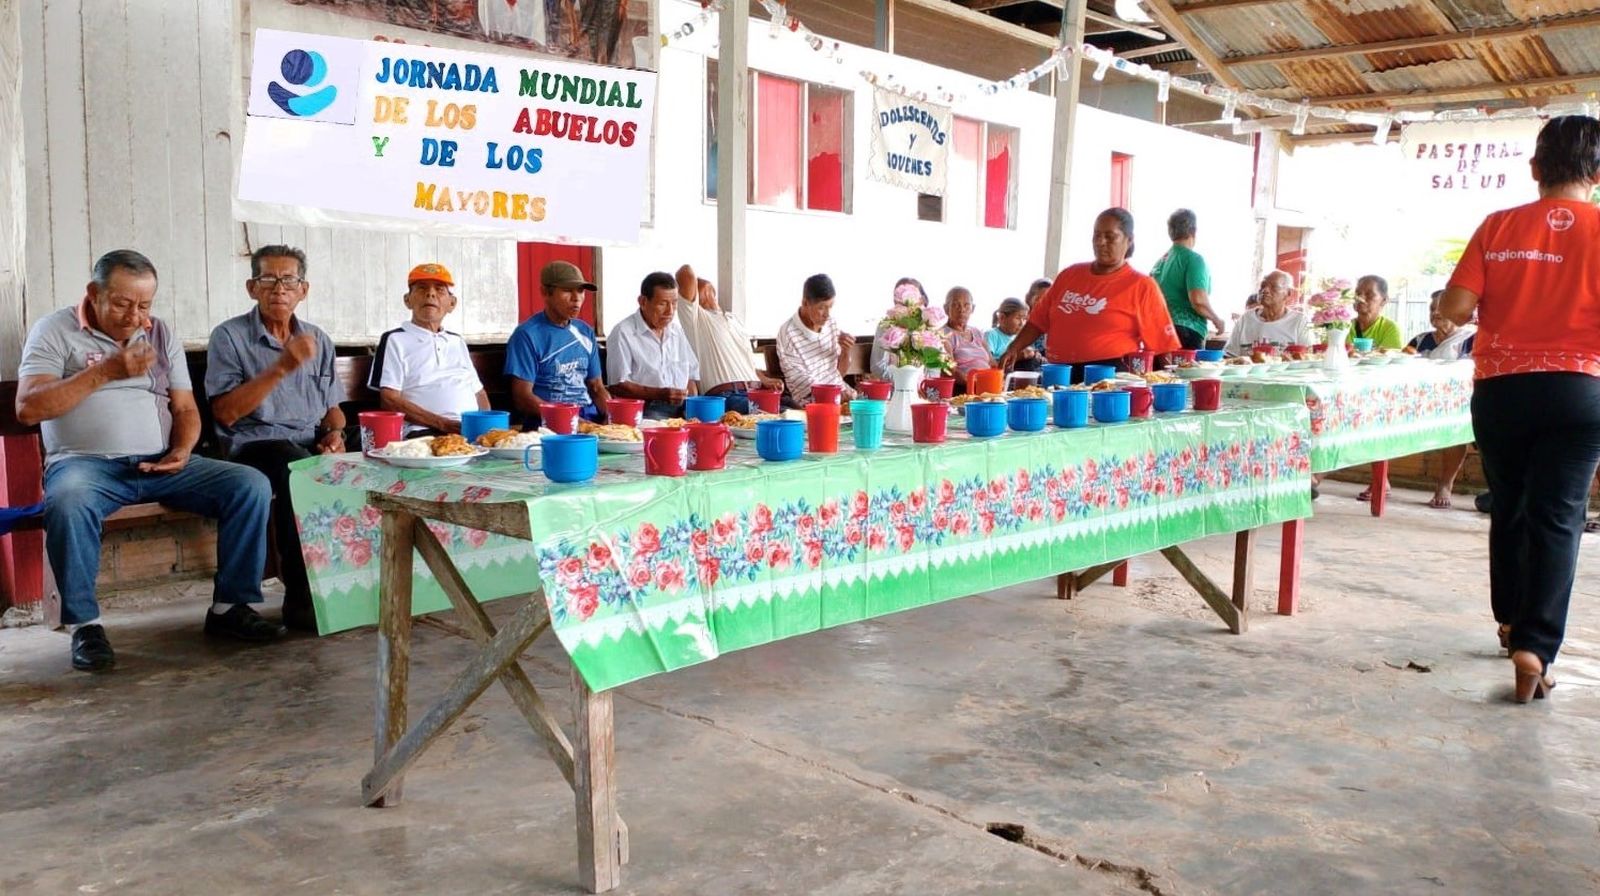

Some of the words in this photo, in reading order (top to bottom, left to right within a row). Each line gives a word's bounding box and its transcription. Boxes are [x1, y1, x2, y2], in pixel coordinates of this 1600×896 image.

[375, 57, 499, 94] JORNADA
[519, 69, 643, 109] MUNDIAL
[373, 96, 409, 125] DE
[424, 99, 477, 130] LOS
[513, 107, 638, 148] ABUELOS
[371, 136, 389, 158] Y
[419, 137, 458, 167] DE
[485, 141, 544, 174] LOS
[909, 133, 917, 150] Y
[1416, 142, 1523, 160] PASTORAL
[1457, 159, 1479, 173] DE
[1431, 174, 1506, 189] SALUD
[413, 181, 547, 222] MAYORES
